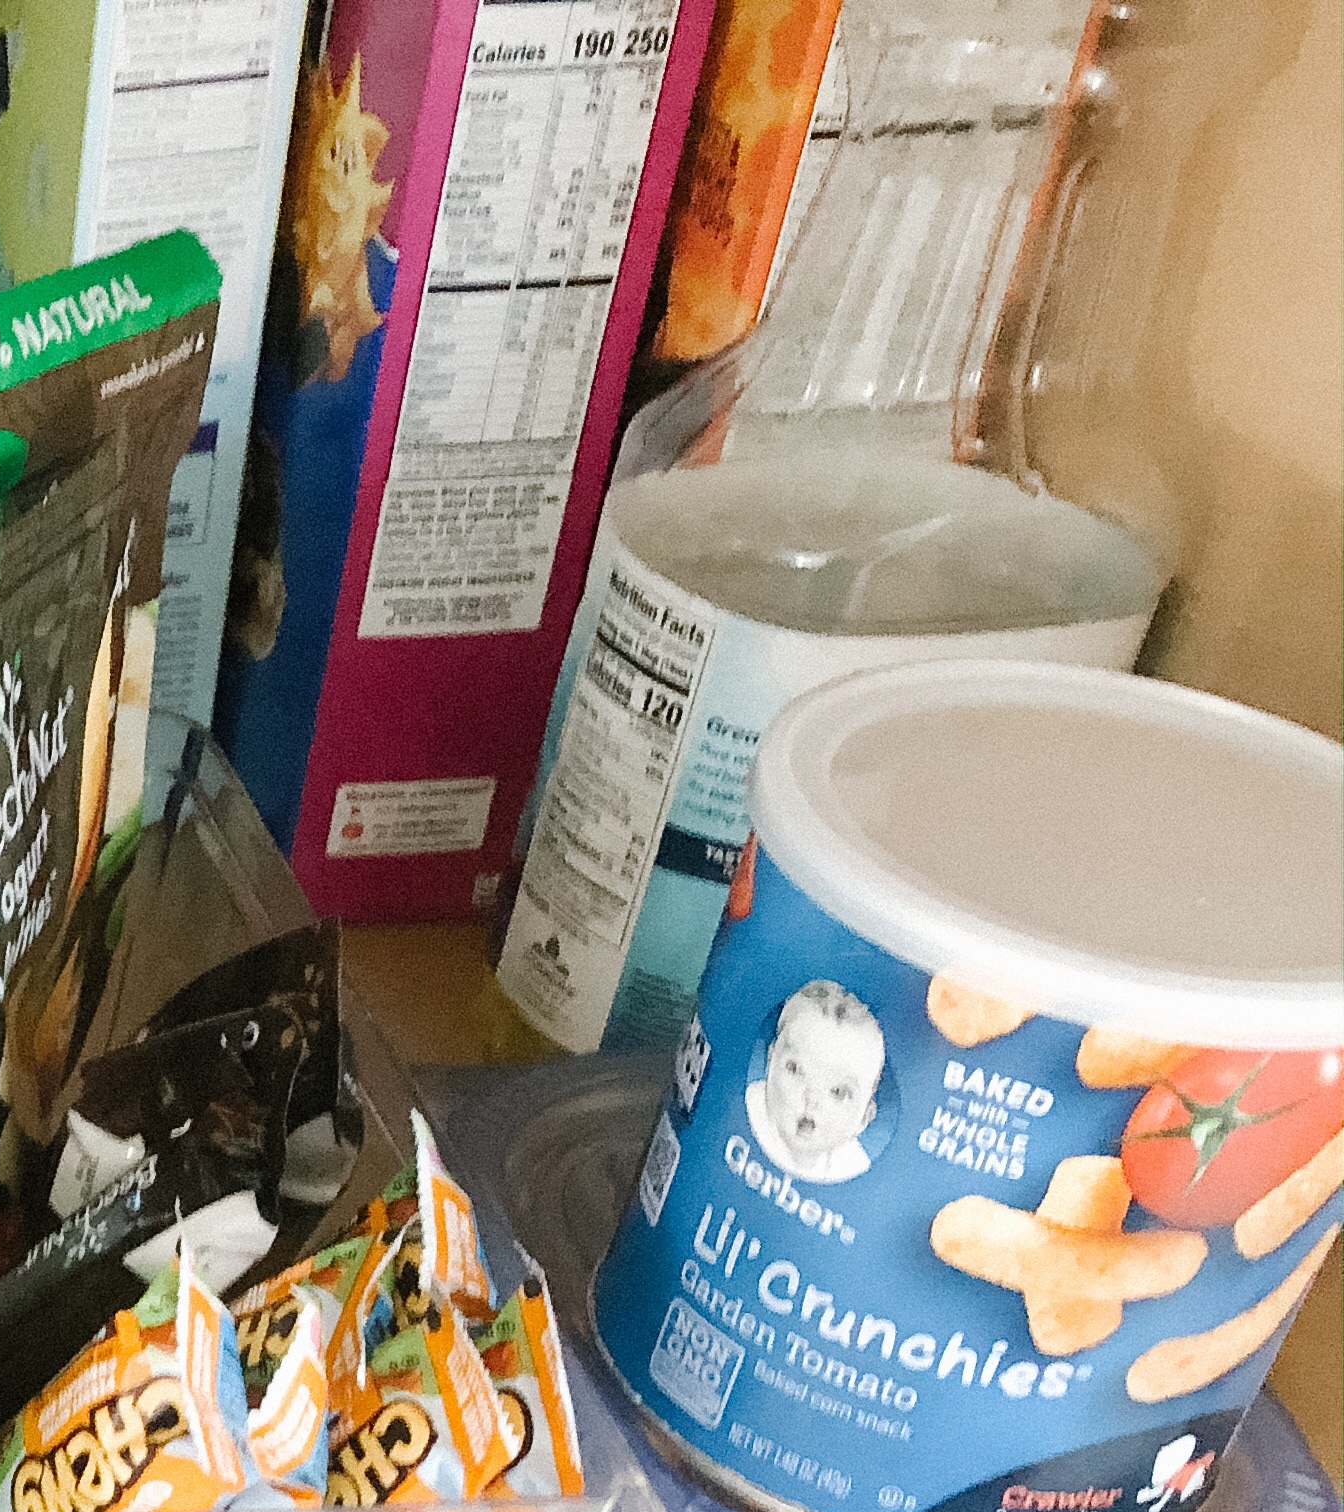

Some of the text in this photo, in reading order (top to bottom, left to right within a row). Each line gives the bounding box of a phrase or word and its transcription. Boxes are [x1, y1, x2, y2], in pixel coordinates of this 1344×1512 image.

[471, 26, 669, 64] Calories 190 250
[12, 274, 153, 361] NATURAL
[642, 686, 684, 732] 120
[943, 1060, 1055, 1117] BAKED
[917, 1127, 1025, 1181] GRAINS
[931, 1105, 1030, 1160] WHOLE
[724, 1134, 844, 1238] Gerber
[675, 1309, 730, 1365] NON
[681, 1258, 919, 1413] Garden Tomato
[757, 1260, 1076, 1400] Crunchies
[666, 1336, 722, 1387] GMO
[855, 1404, 914, 1443] snack
